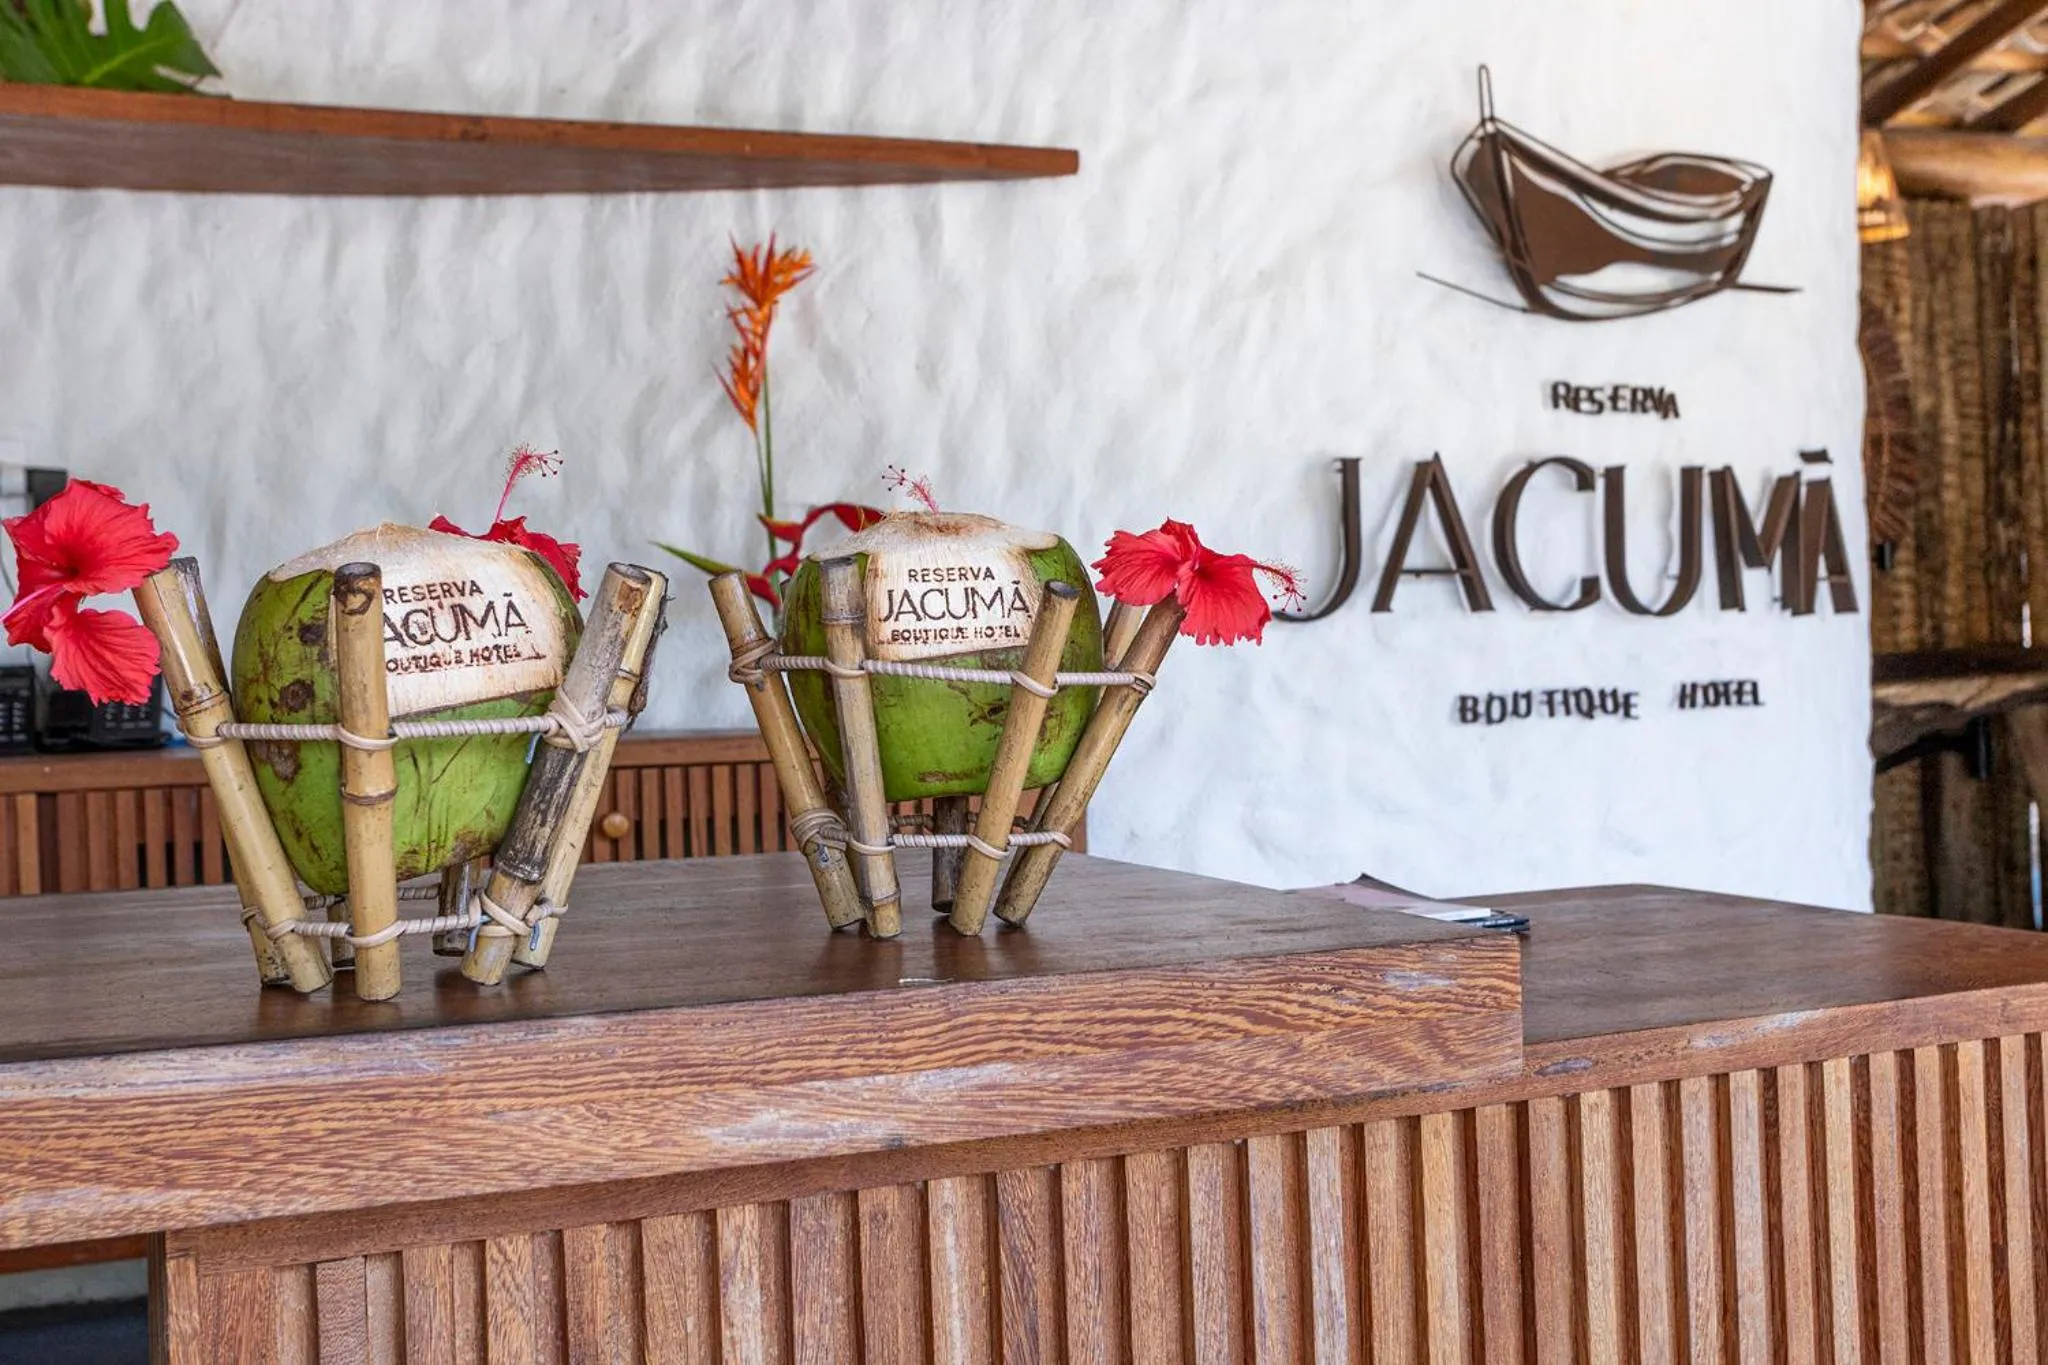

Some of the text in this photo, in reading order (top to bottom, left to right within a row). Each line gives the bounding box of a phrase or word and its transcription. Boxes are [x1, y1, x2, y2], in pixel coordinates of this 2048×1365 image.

[1549, 381, 1680, 420] RESERVA
[1271, 449, 1859, 623] JACUMÃ
[383, 580, 485, 606] RESERVA
[908, 566, 996, 583] RESERVA
[383, 592, 528, 649] ACUMÃ
[878, 580, 1032, 622] JACUMÃ
[891, 624, 1021, 643] BOUTIQUE HOTEL
[386, 650, 465, 674] OUTIQUE
[1458, 680, 1765, 725] BOUTIQUE HOTEL
